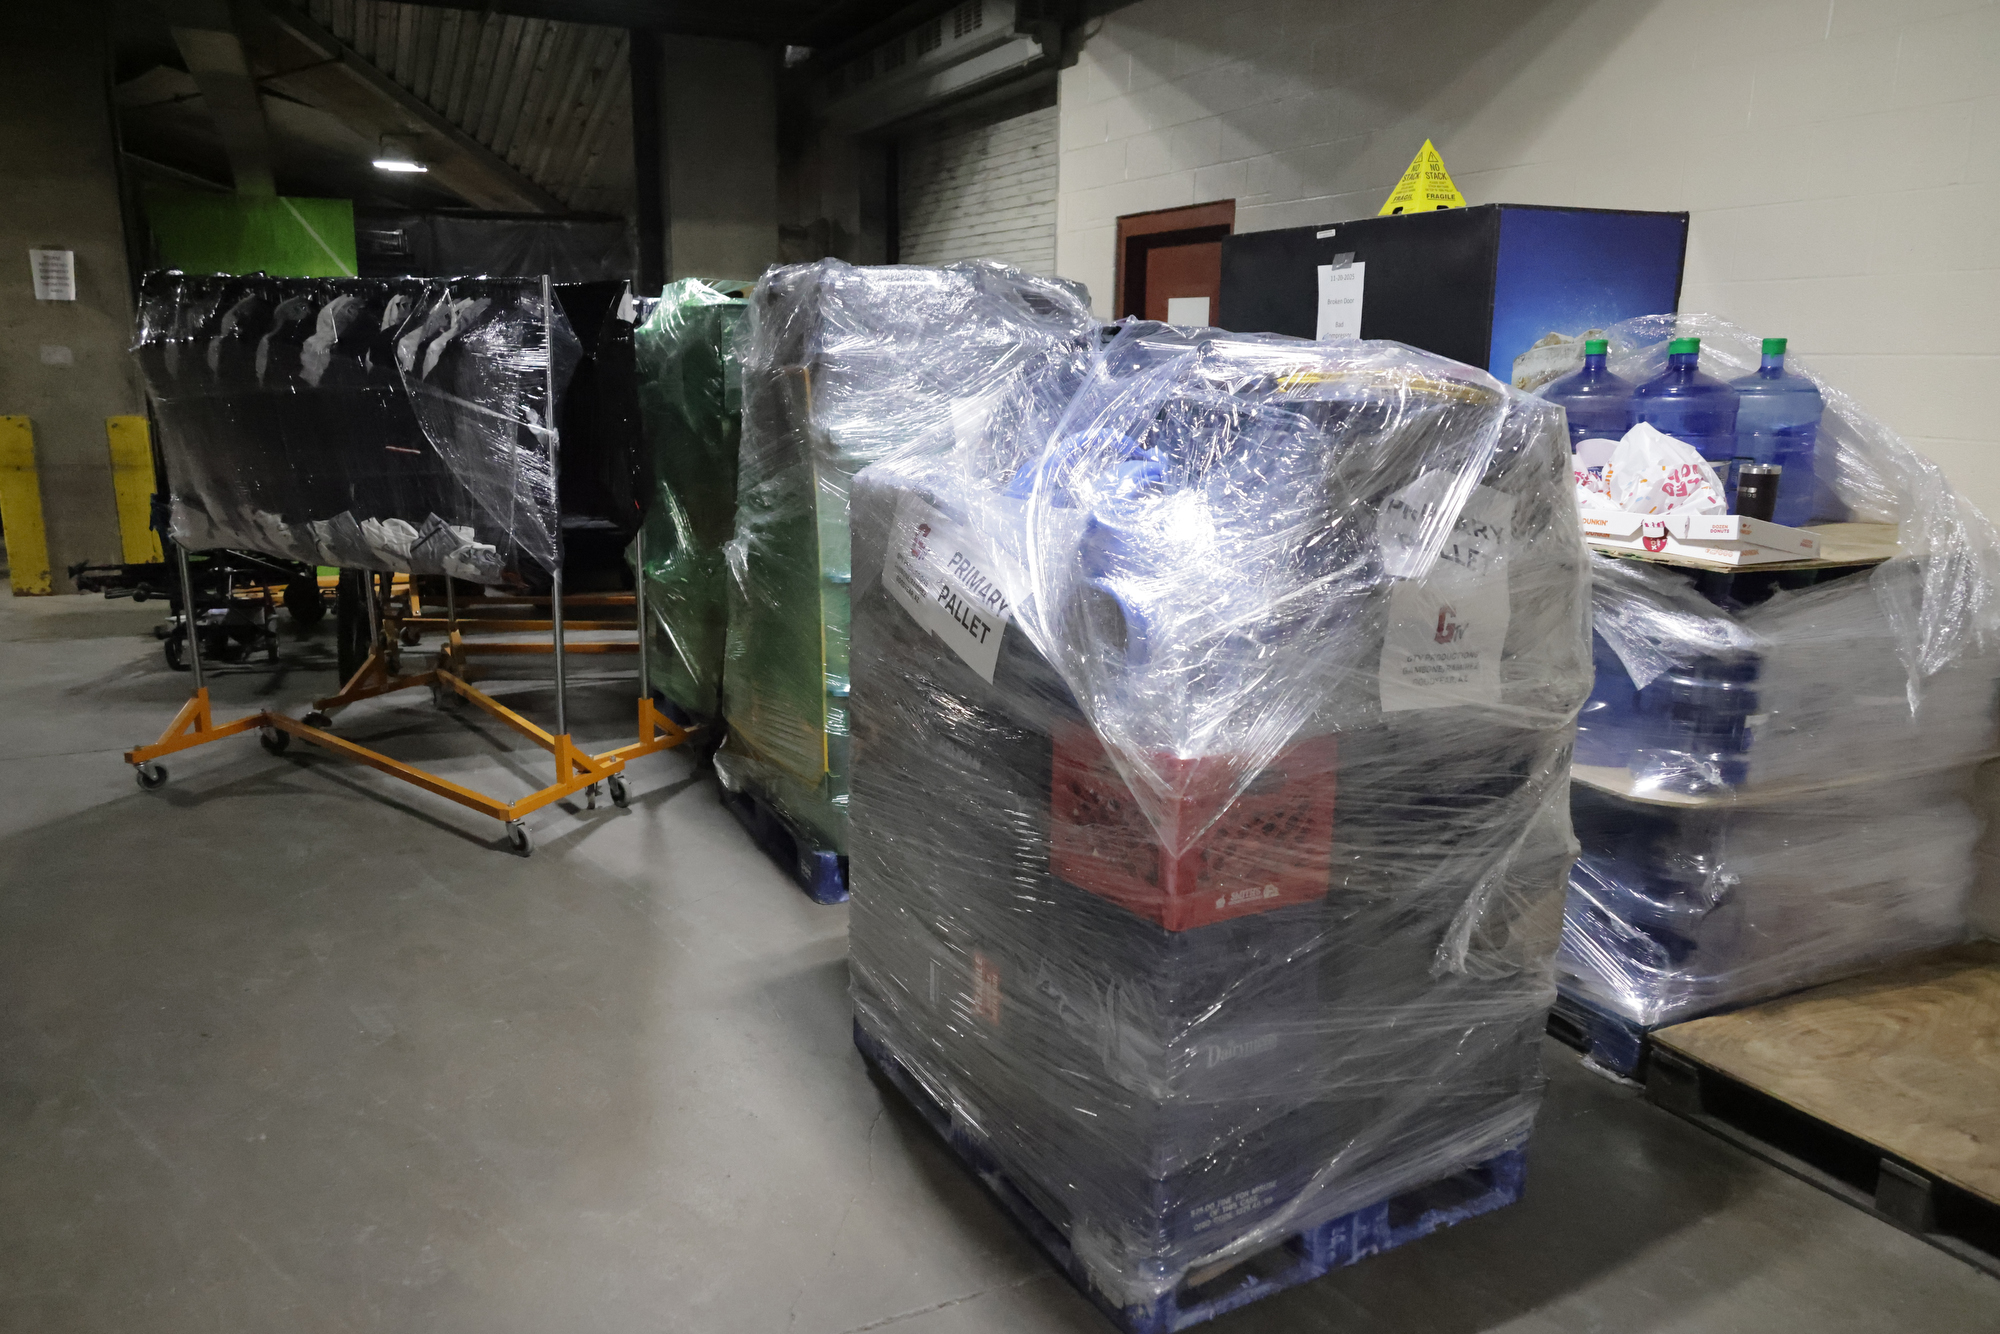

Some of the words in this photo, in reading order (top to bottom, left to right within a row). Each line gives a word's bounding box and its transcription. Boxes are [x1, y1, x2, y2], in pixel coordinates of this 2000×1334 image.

[1425, 172, 1447, 180] STACK
[1386, 499, 1504, 544] PRIARY
[1399, 532, 1495, 577] PLLET
[947, 550, 1009, 617] PRIMARY
[937, 585, 991, 644] PALLET
